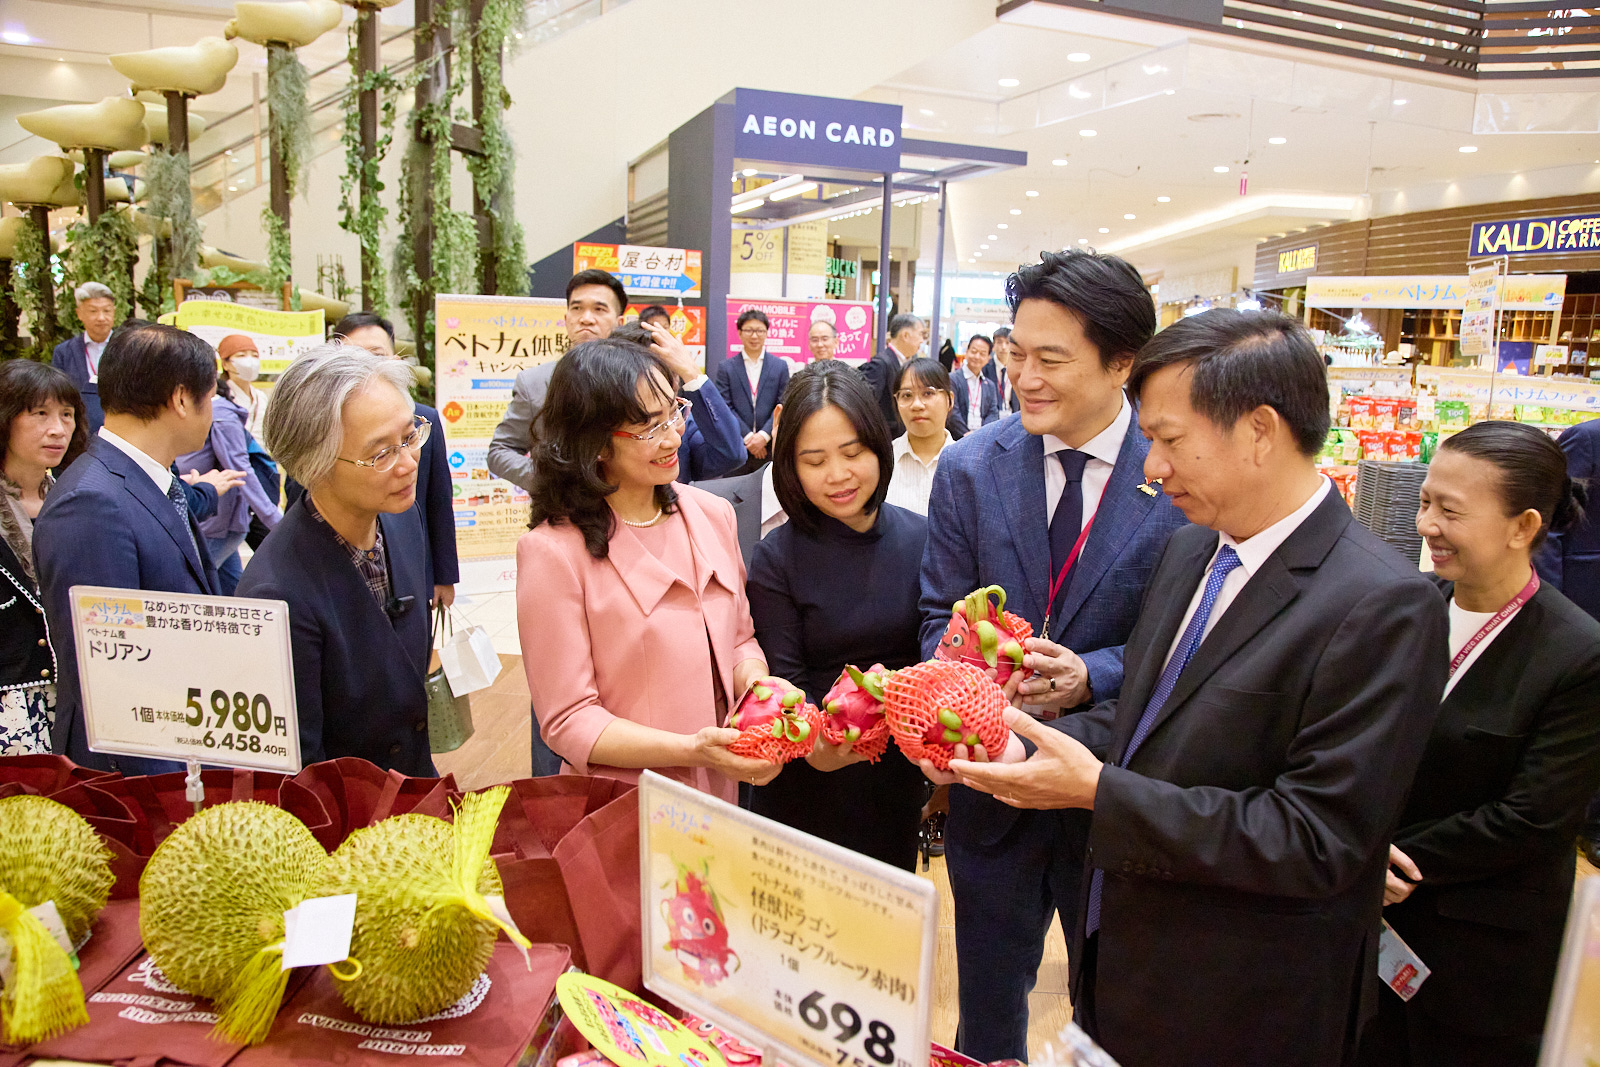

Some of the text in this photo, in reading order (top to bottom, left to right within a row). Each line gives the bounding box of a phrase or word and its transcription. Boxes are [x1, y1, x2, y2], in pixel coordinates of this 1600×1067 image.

[743, 114, 895, 148] AEON CARD
[1477, 221, 1557, 253] KALDI
[741, 232, 775, 261] 5%
[622, 251, 683, 271] 屋台村
[755, 252, 774, 261] OFF
[614, 274, 677, 289] 場で開催中!!
[763, 305, 796, 315] MOBILE
[475, 360, 541, 373] キャンペー
[1499, 386, 1578, 402] ベトナムフェア
[1353, 404, 1370, 413] Tipo
[1376, 405, 1393, 415] Tipo
[1447, 409, 1464, 418] Tipo
[1365, 441, 1384, 451] Tipo
[1390, 443, 1407, 454] Tipo
[91, 603, 132, 615] ベトナム
[144, 600, 274, 622] なめらかで濃厚な甘さと
[101, 614, 125, 625] フェア
[146, 615, 263, 636] 豊かな香りが特徴です
[87, 627, 127, 640] ベトナム産
[88, 640, 151, 662] ドリアン
[131, 706, 155, 723] 1個
[751, 886, 838, 939] 怪獣ドラゴン
[297, 1012, 433, 1043] FRESH DURIAN
[798, 990, 913, 1067] 698
[357, 1039, 467, 1057] KING FRUIT
